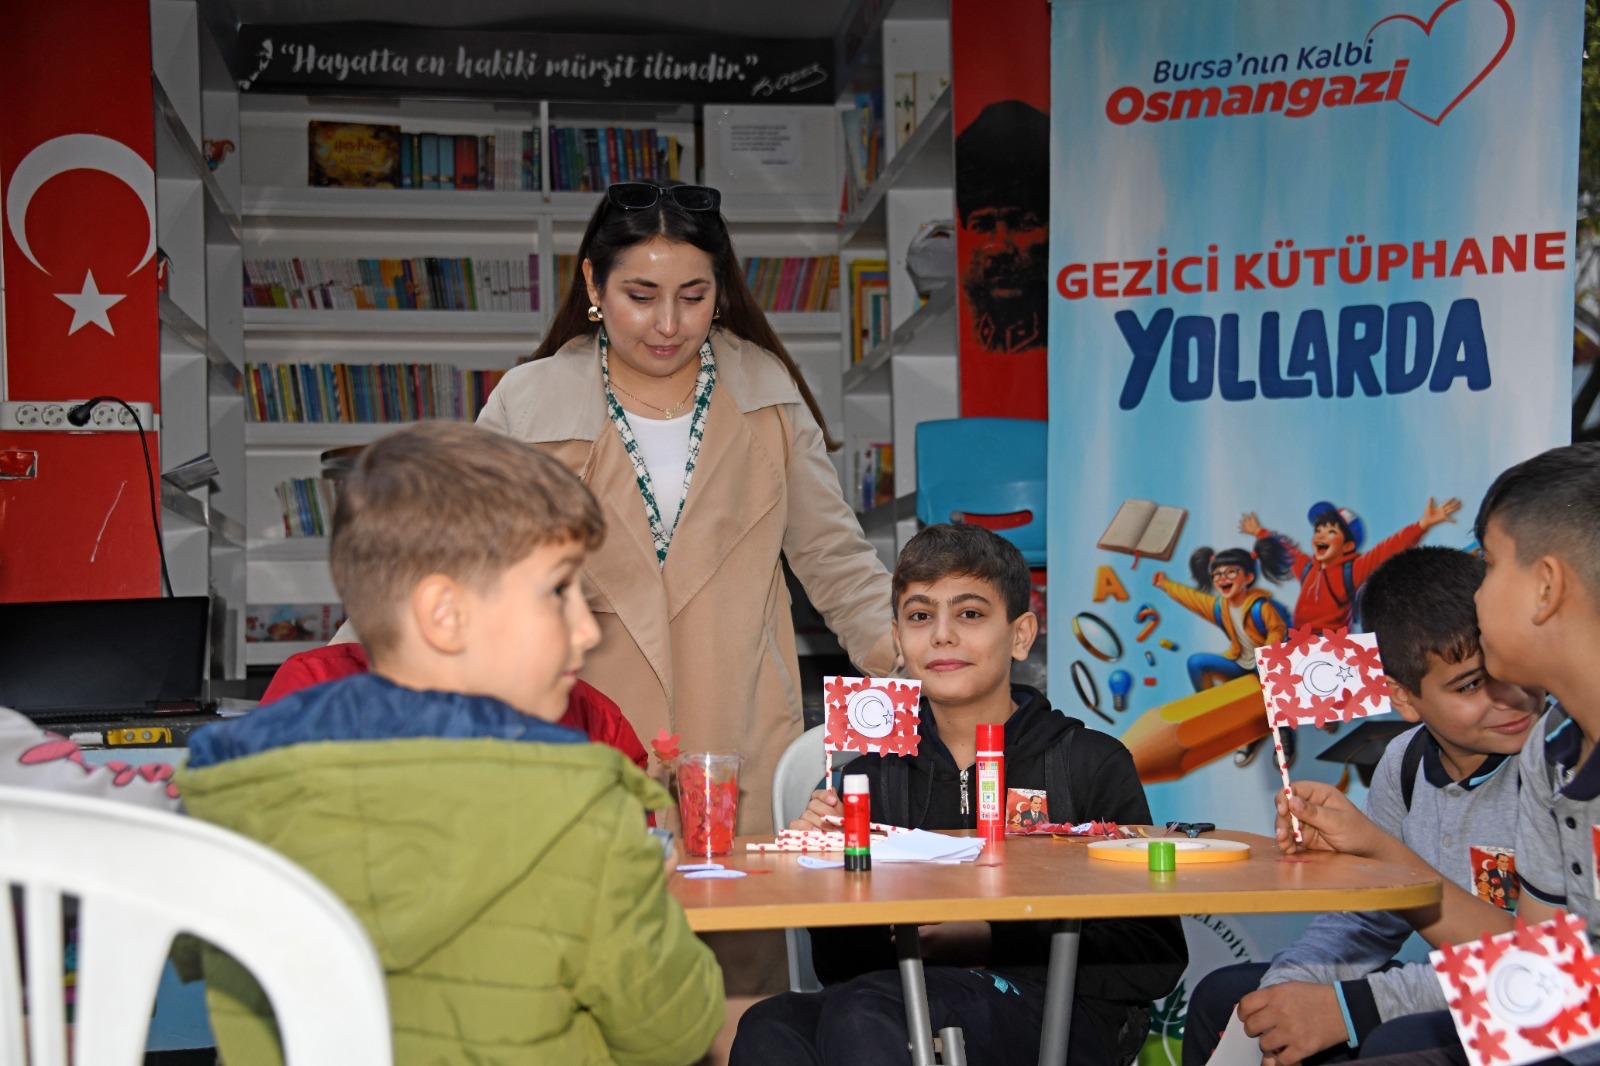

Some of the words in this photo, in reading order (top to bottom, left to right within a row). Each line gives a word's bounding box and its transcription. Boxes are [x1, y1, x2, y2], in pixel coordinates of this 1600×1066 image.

[281, 44, 408, 81] "Hayatta
[415, 56, 446, 77] en
[455, 46, 538, 80] hakiki
[545, 54, 638, 87] mürşit
[643, 51, 758, 83] ilimdir."
[1153, 50, 1289, 84] Bursa'nın
[1297, 38, 1375, 71] Kalbi
[1105, 59, 1409, 125] Osmangazi
[1056, 244, 1219, 300] GEZİCİ
[1234, 231, 1567, 291] KÜTÜPHANE
[1114, 298, 1492, 411] YOLLARDA
[1092, 564, 1130, 603] A
[1190, 913, 1252, 963] LEDİY
